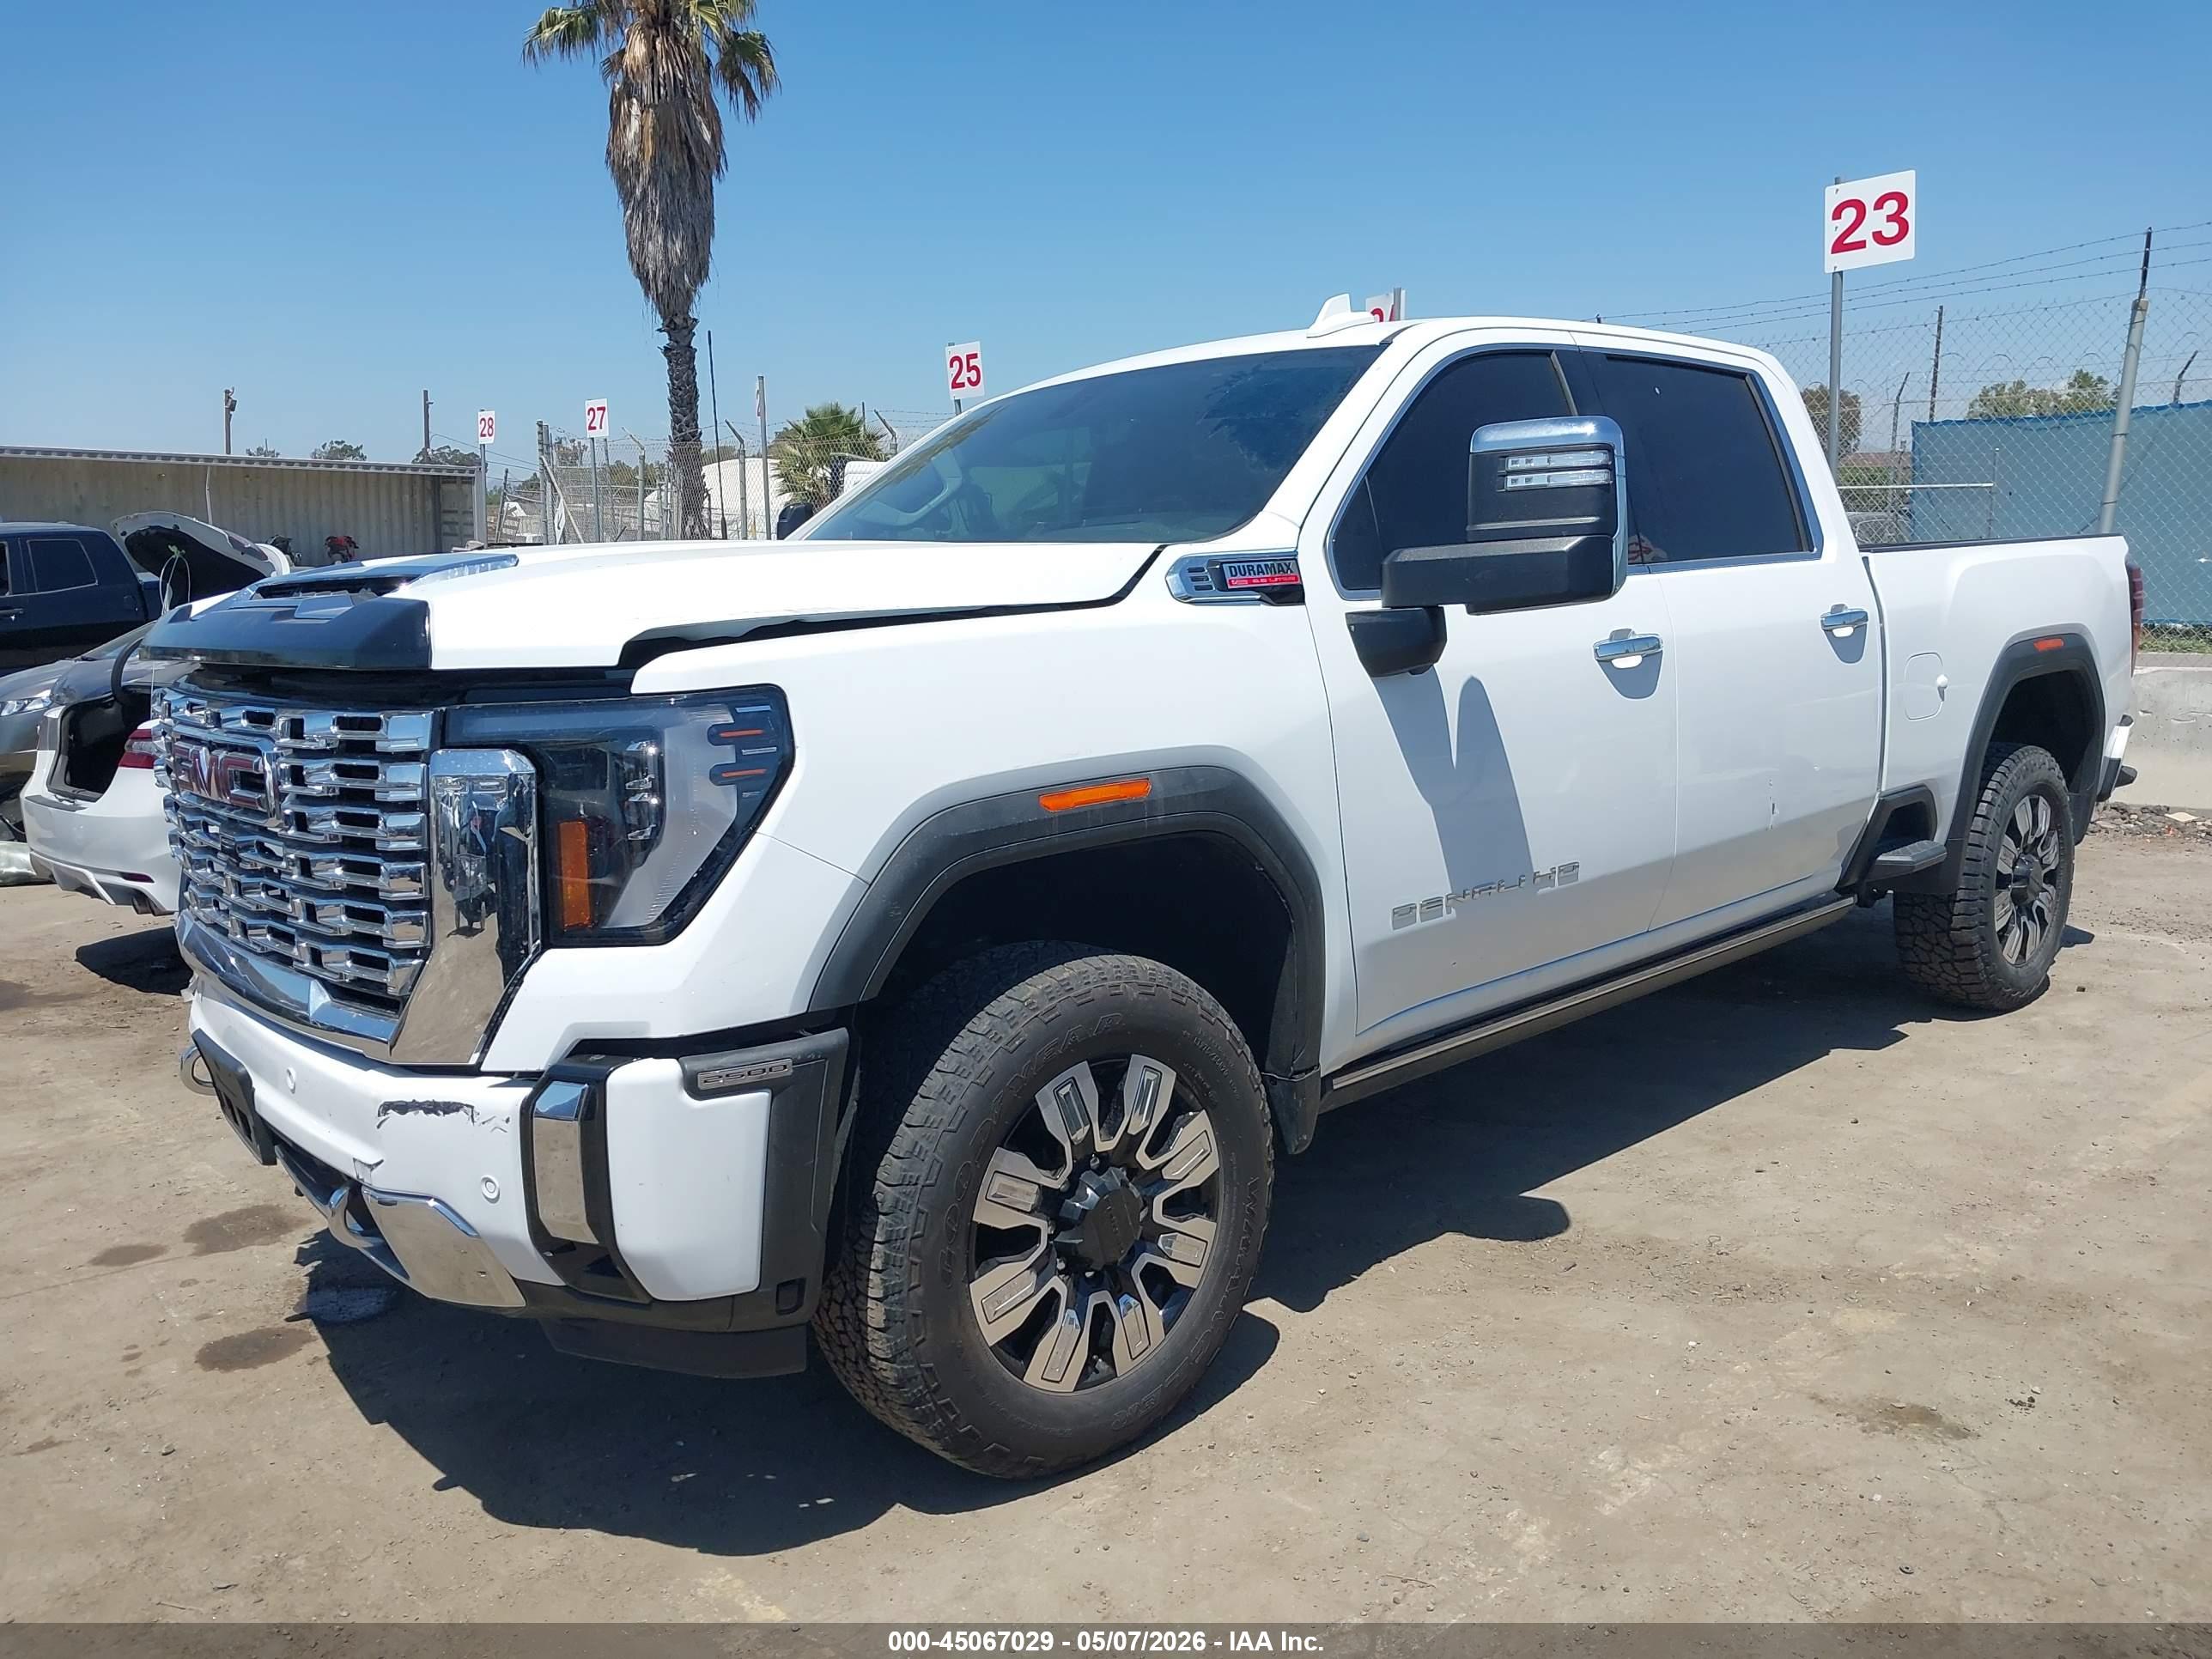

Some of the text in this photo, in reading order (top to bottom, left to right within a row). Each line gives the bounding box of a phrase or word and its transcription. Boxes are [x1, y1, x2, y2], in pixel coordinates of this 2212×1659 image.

[1830, 191, 1910, 255] 23
[949, 352, 981, 390] 25
[479, 416, 495, 438] 28
[586, 405, 606, 431] 27
[1228, 562, 1294, 578] DURAMAX
[173, 741, 266, 811] GMC
[1533, 861, 1580, 894] HD
[702, 1063, 788, 1085] 2500
